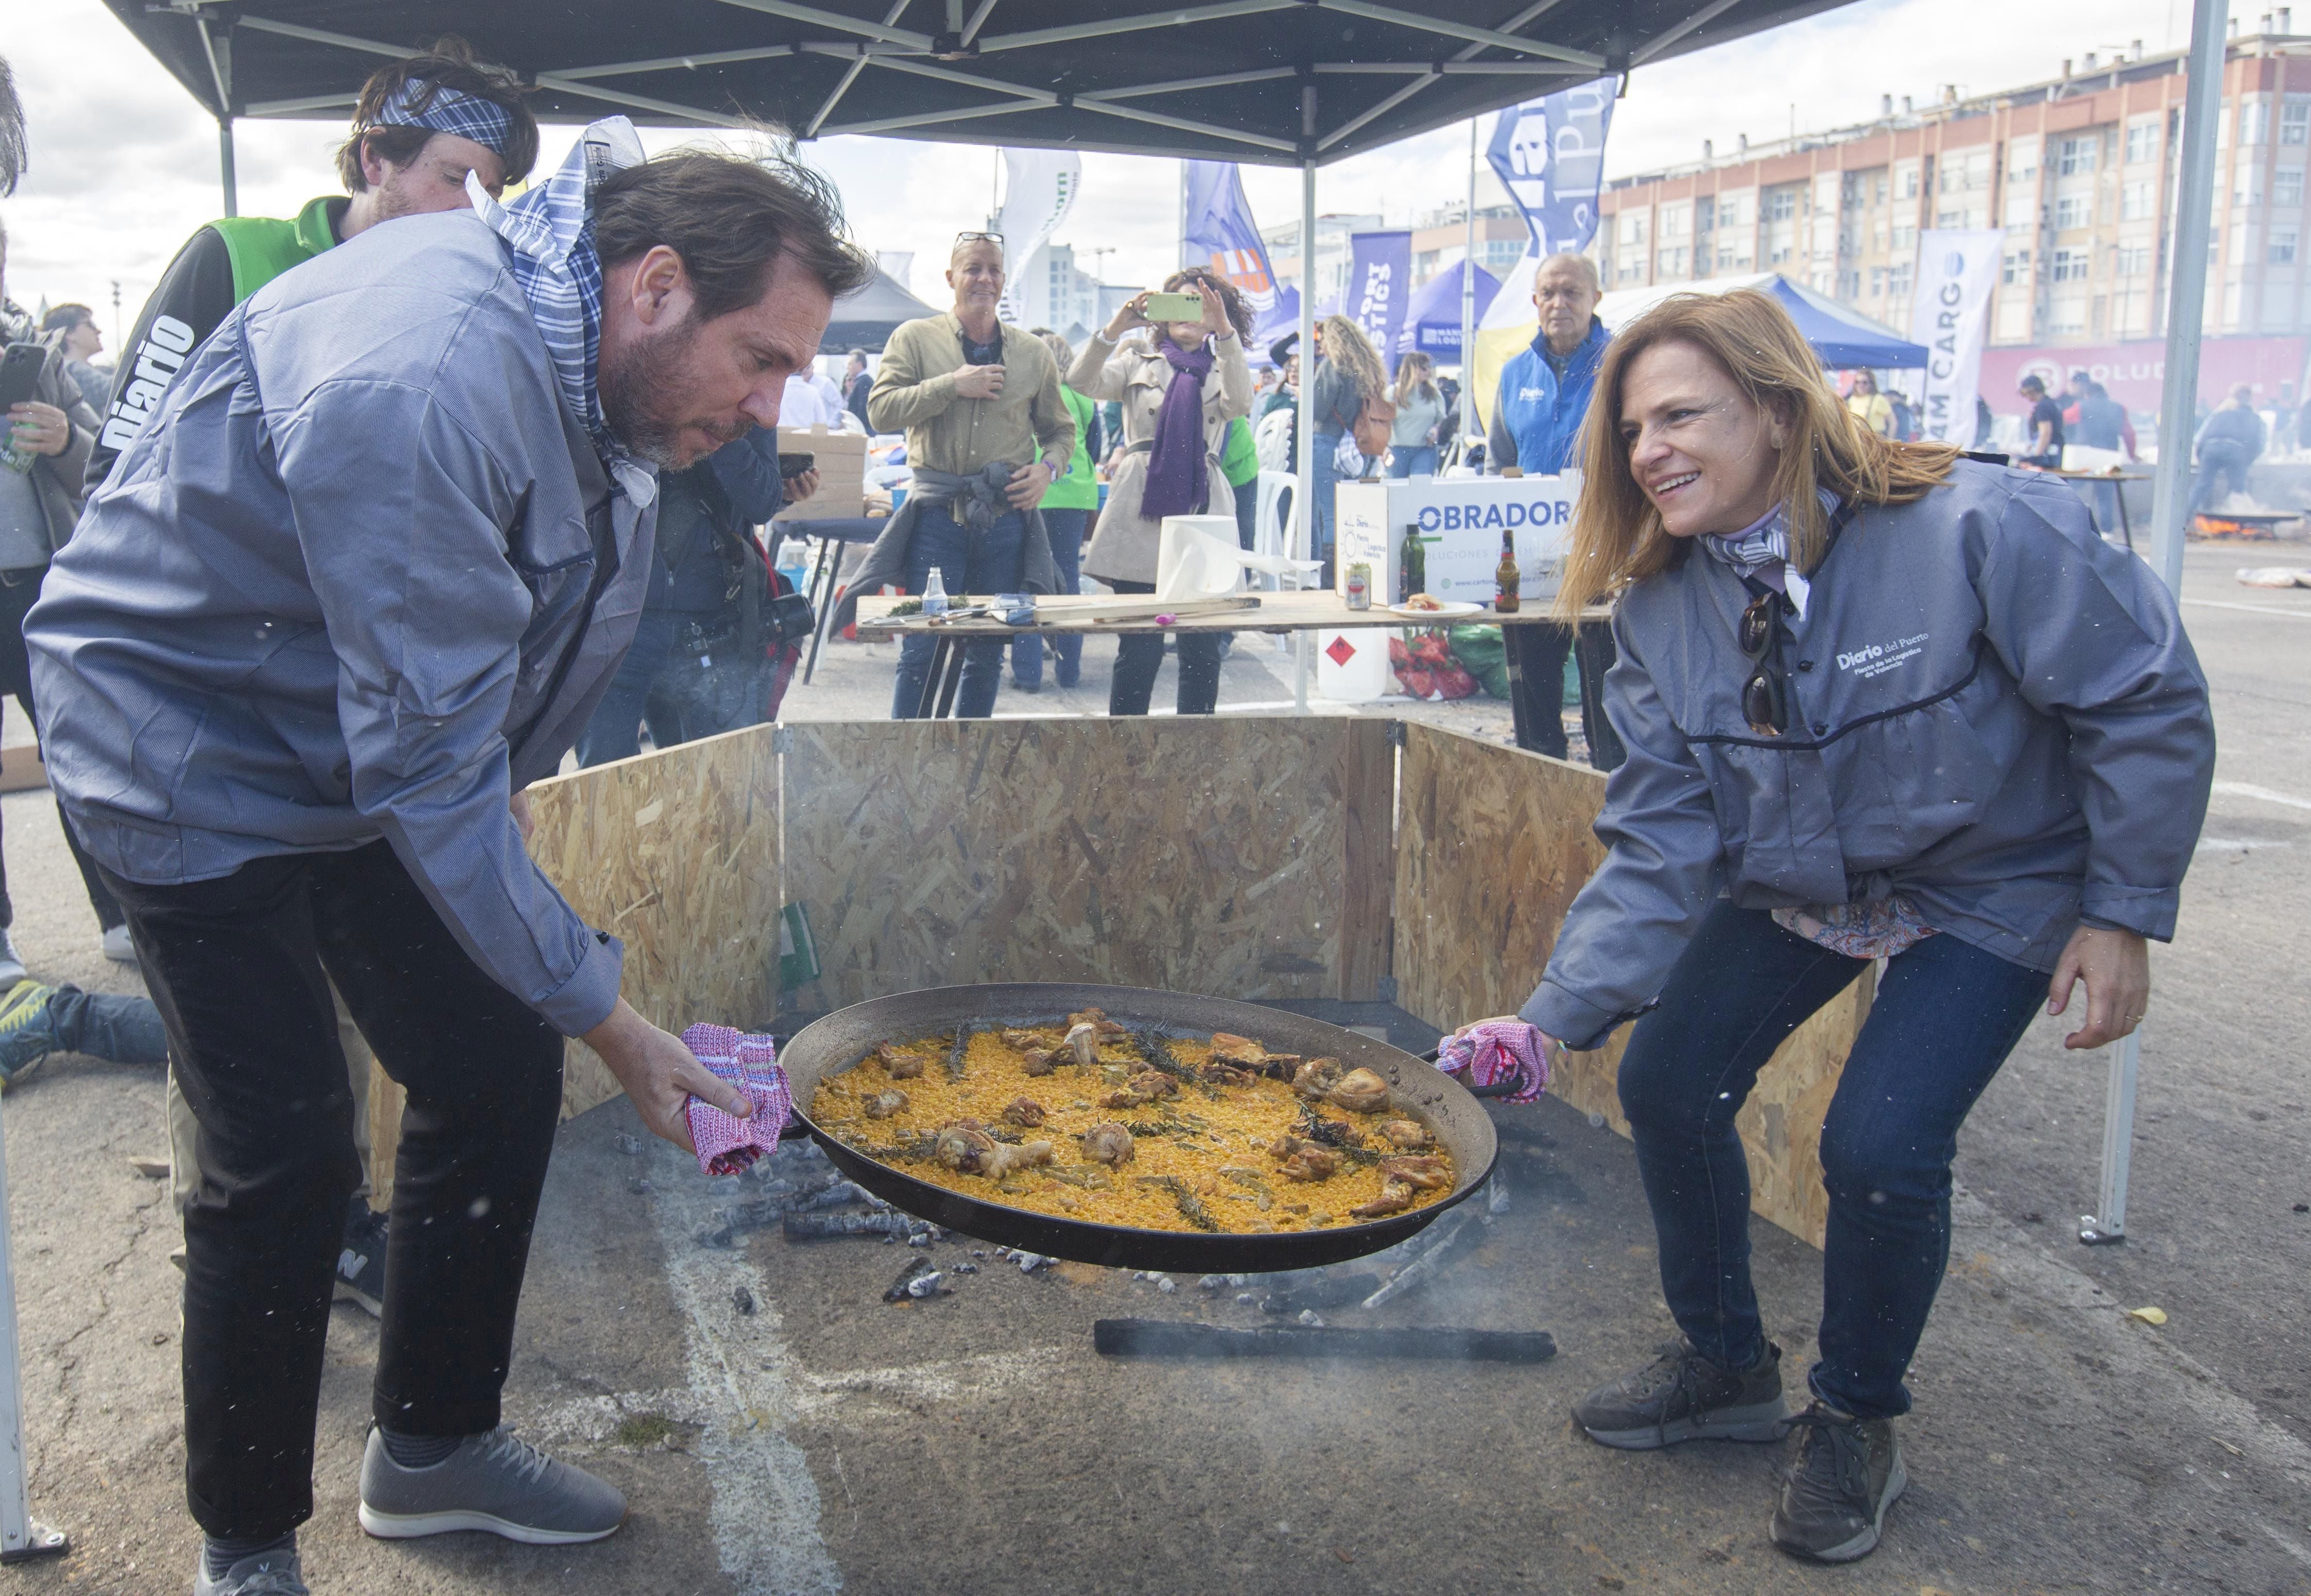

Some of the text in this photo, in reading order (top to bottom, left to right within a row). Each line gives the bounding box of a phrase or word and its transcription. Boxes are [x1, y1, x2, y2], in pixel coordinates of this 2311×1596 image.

[1417, 500, 1571, 532] OBRADOR
[1423, 549, 1488, 561] OLUCIONES
[1836, 633, 1929, 670] Diario del Puerto
[1854, 664, 1875, 675] Fiesta
[1874, 661, 1903, 674] Valencia
